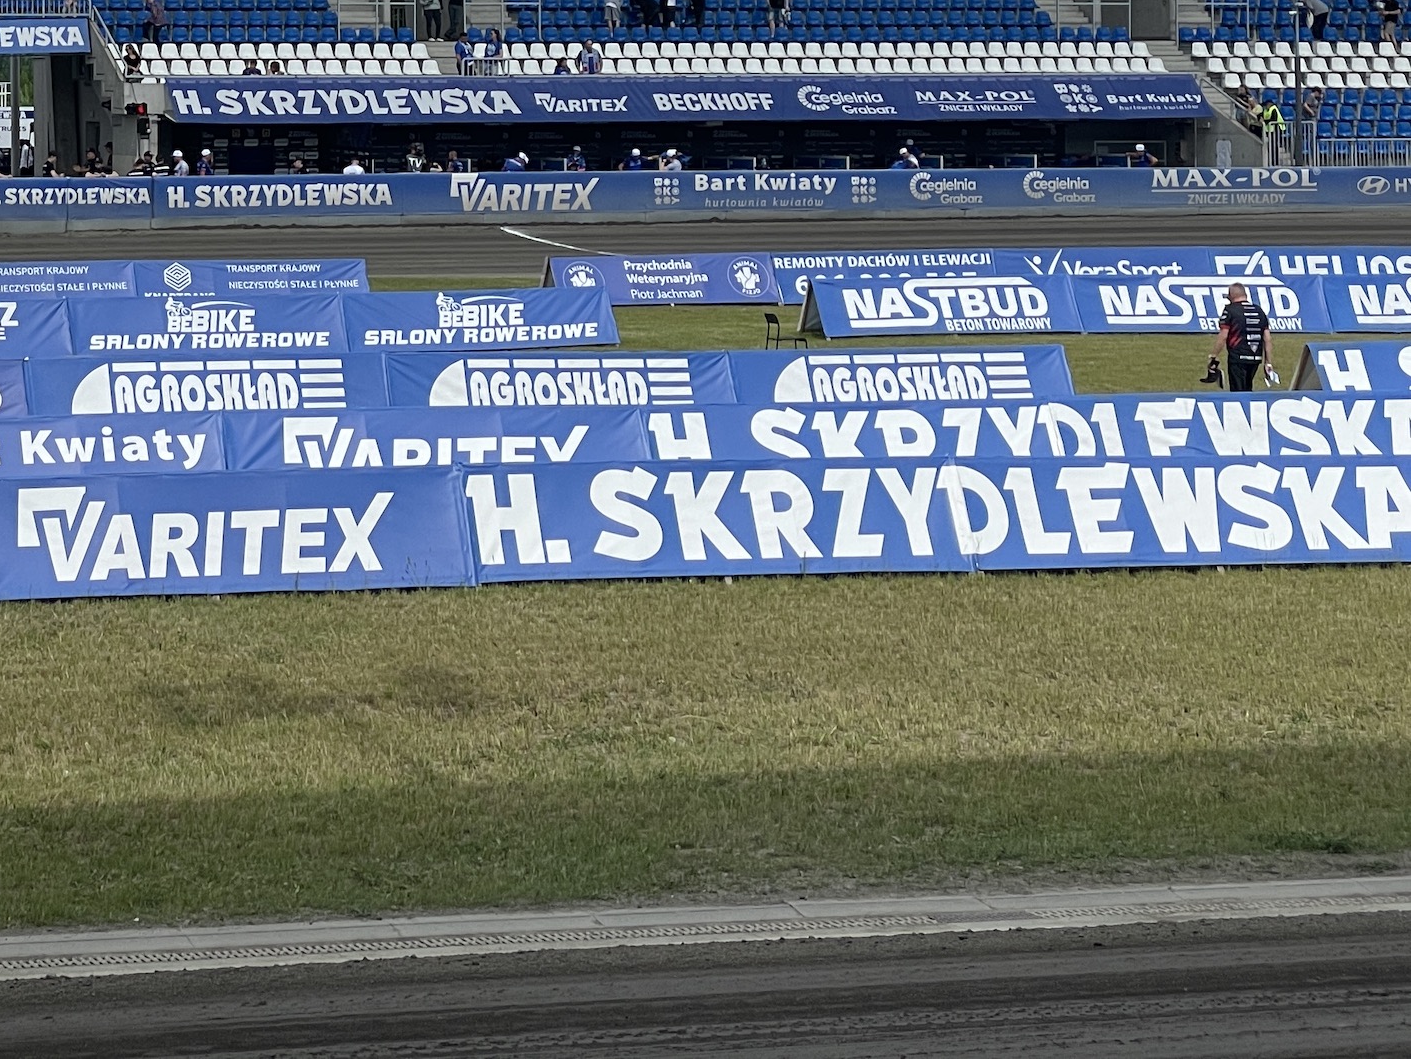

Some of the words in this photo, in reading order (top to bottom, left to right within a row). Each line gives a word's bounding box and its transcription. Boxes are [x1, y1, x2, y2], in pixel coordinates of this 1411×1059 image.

[173, 89, 212, 115] H.
[219, 88, 522, 115] SKRZYDLEWSKA
[541, 95, 628, 113] VARITEX
[653, 92, 774, 112] BECKHOFF
[915, 90, 1035, 102] MAX-POL
[1106, 94, 1144, 104] Bart
[842, 104, 897, 115] Grabarz
[939, 103, 975, 112] ZNICZE
[409, 157, 423, 168] TV
[695, 174, 746, 192] Bart
[755, 173, 837, 195] Kwiaty
[1152, 169, 1317, 188] MAX-POL
[4, 187, 151, 205] SKRZYDLEWSKA
[167, 186, 190, 208] H.
[195, 183, 393, 208] SKRZYDLEWSKA
[460, 177, 600, 211] VARITEX
[704, 197, 766, 208] hurtownia
[772, 195, 824, 207] kwiatów
[940, 193, 983, 204] Grabarz
[1053, 192, 1096, 203] Grabarz
[1187, 193, 1229, 205] ZNICZE
[226, 264, 277, 273] TRANSPORT
[279, 264, 321, 272] KRAJOWY
[623, 260, 692, 272] Przychodnia
[773, 256, 844, 269] REMONTY
[848, 253, 910, 267] DACHÓW
[922, 253, 992, 266] ELEWACJI
[46, 266, 90, 274] KRAJOWY
[57, 282, 85, 291] STAŁE
[92, 281, 128, 290] PŁYNNE
[228, 279, 288, 289] NIECZYSTOŚCI
[290, 279, 318, 289] STAŁE
[324, 279, 359, 289] PŁYNNE
[626, 272, 709, 286] Weterynaryjna
[631, 288, 654, 299] Piotr
[656, 287, 703, 299] Jachman
[842, 277, 1049, 328] NASTBUD
[945, 317, 983, 331] BETON
[984, 317, 1052, 331] TOWAROWY
[90, 334, 190, 350] SALONY
[192, 331, 330, 349] ROWEROWE
[364, 328, 462, 346] SALONY
[463, 323, 598, 344] ROWEROWE
[469, 370, 649, 407] AGROSKŁAD
[812, 364, 989, 403] AGROSKŁAD
[114, 372, 300, 414] AGROSKŁAD
[21, 426, 207, 471] Kwiaty
[465, 473, 572, 566] H.
[589, 461, 1411, 561] SKRZYDLEWSKA
[41, 491, 395, 583] VARITEX
